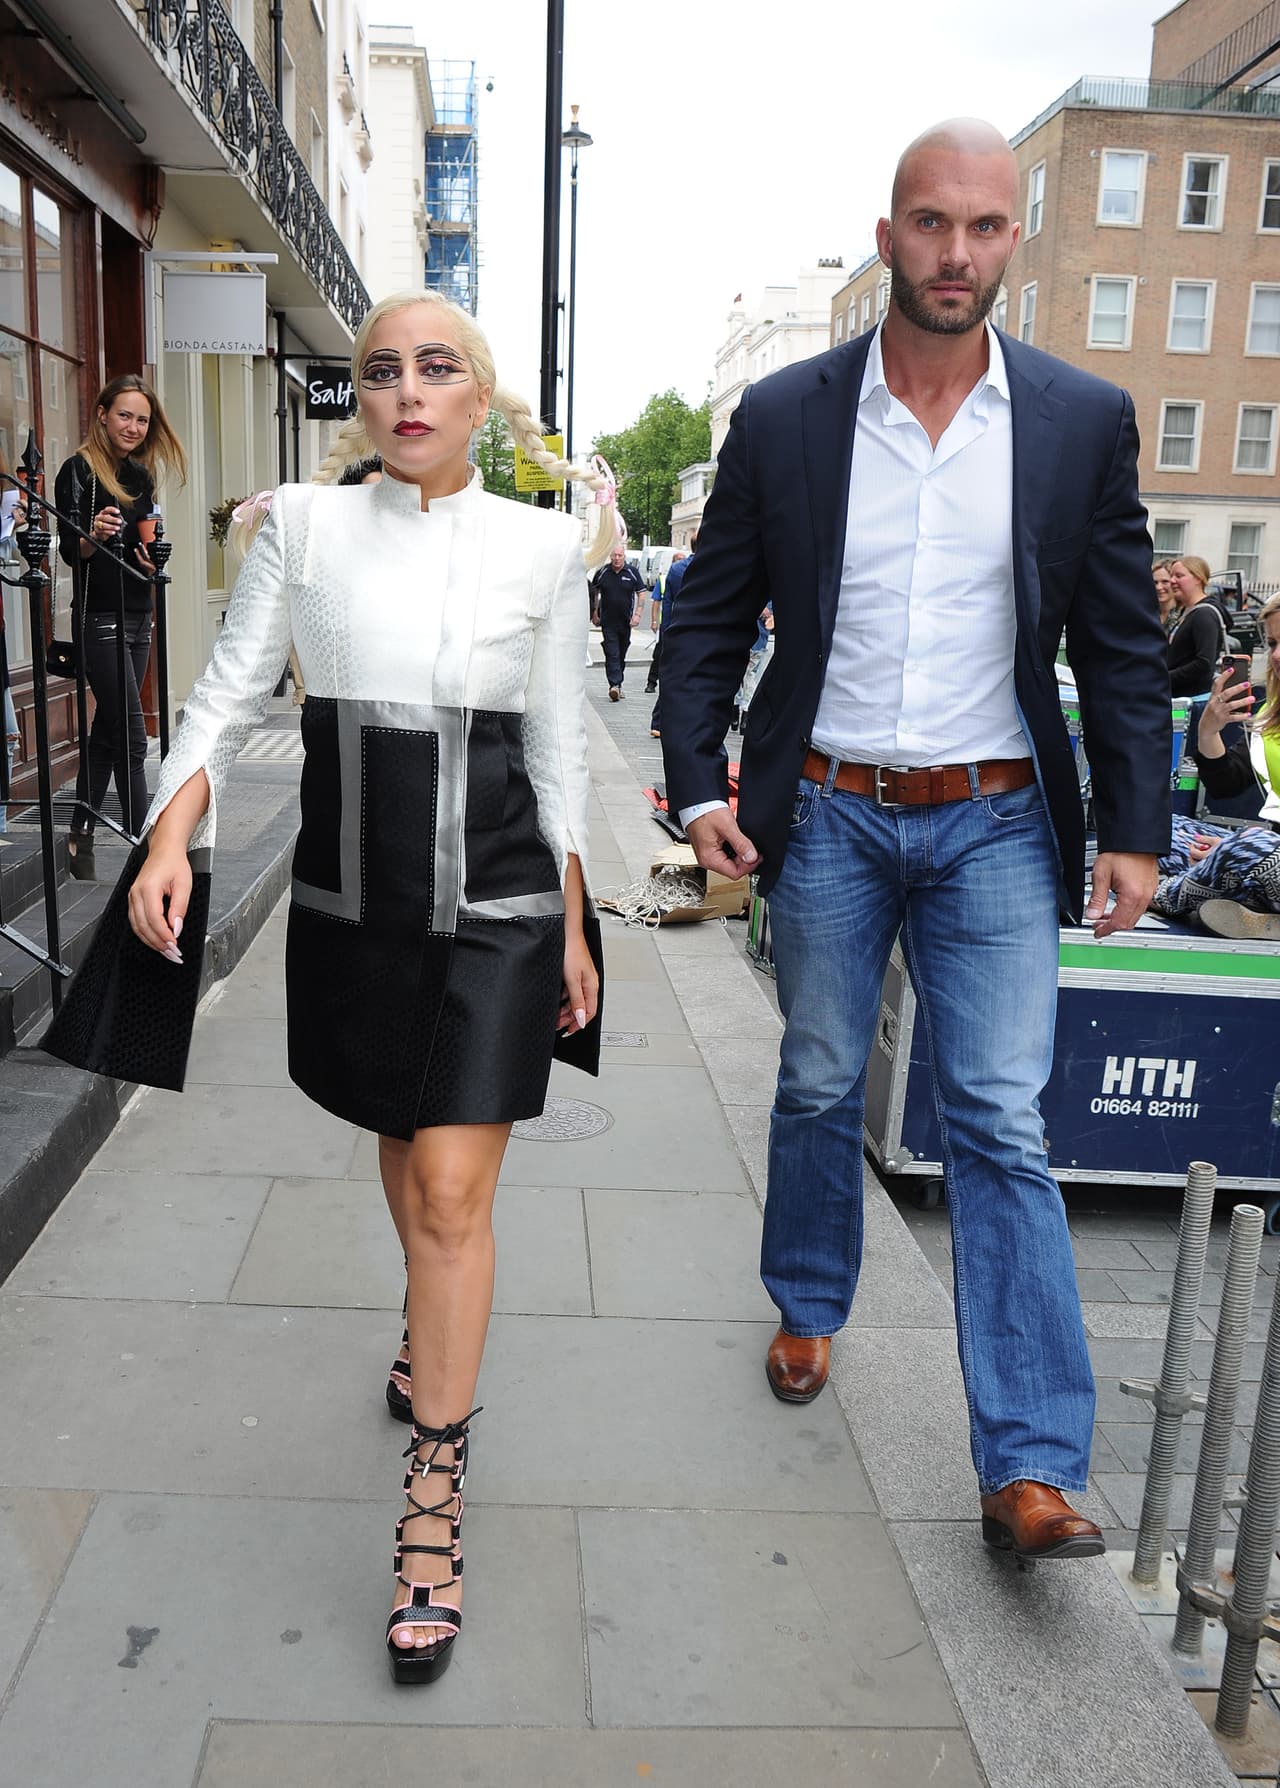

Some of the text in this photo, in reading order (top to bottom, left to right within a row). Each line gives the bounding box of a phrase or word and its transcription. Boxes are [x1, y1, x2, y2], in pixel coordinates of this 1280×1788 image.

[164, 340, 264, 351] BIONDA CASTANA
[309, 380, 354, 407] Salt
[1101, 1056, 1197, 1098] HTH
[1090, 1098, 1199, 1118] 01664 821111
